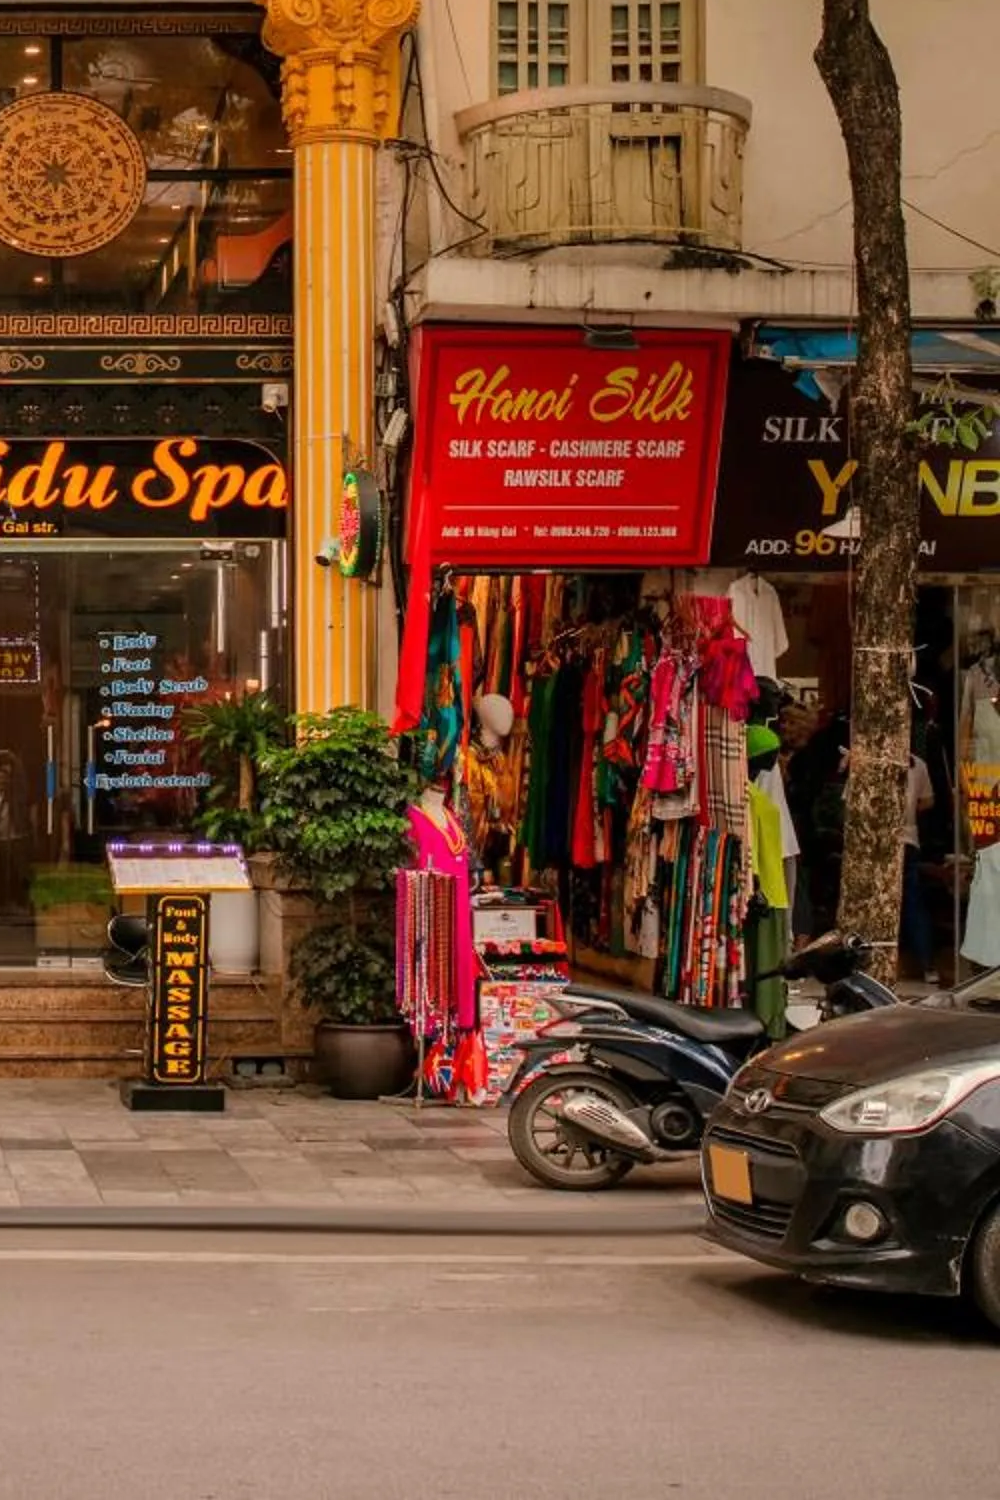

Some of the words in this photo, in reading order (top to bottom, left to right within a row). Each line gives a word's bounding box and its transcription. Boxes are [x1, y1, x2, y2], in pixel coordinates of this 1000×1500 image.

[450, 365, 579, 424] Hanoi
[589, 360, 693, 422] Silk
[762, 416, 843, 443] SILK
[449, 439, 482, 458] SILK
[486, 439, 536, 458] SCARF
[549, 439, 632, 458] CASHMERE
[635, 439, 685, 458] SCARF
[132, 437, 288, 521] Spa
[503, 469, 573, 487] RAWSILK
[575, 469, 625, 487] SCARF
[807, 460, 1000, 516] YNB
[3, 520, 29, 533] Gai
[32, 521, 58, 533] str.
[745, 540, 790, 555] ADD:
[794, 530, 836, 556] 96
[113, 632, 157, 650] Body
[112, 658, 151, 672] Foot
[111, 677, 155, 696] Body
[159, 676, 209, 694] Scrub
[112, 702, 174, 719] Waxing
[114, 750, 166, 765] Facial
[166, 906, 198, 918] Foot
[175, 920, 188, 931] &
[163, 931, 199, 946] Body
[162, 951, 197, 1074] MASSAGE
